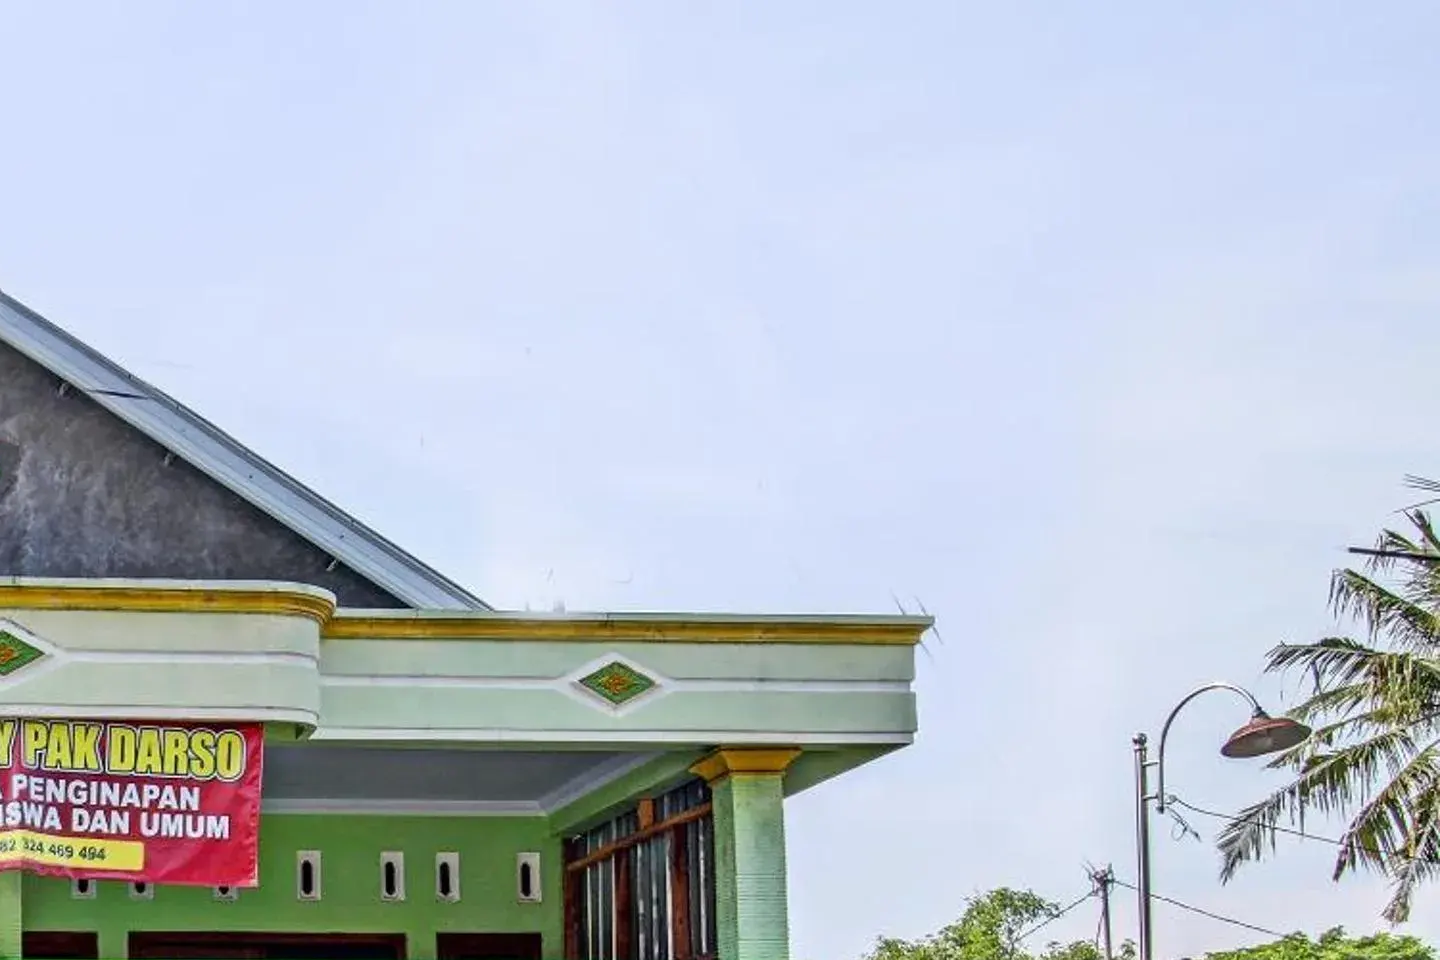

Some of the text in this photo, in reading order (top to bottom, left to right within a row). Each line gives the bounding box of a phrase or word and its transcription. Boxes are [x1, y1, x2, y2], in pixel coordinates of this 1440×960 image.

[21, 719, 103, 773] PAK
[106, 723, 246, 782] DARSO
[12, 773, 201, 811] PENGINAPAN
[71, 807, 130, 835] DAN
[140, 811, 230, 839] UMUM
[22, 837, 45, 853] 324
[48, 841, 74, 858] 469
[78, 846, 107, 861] 494
